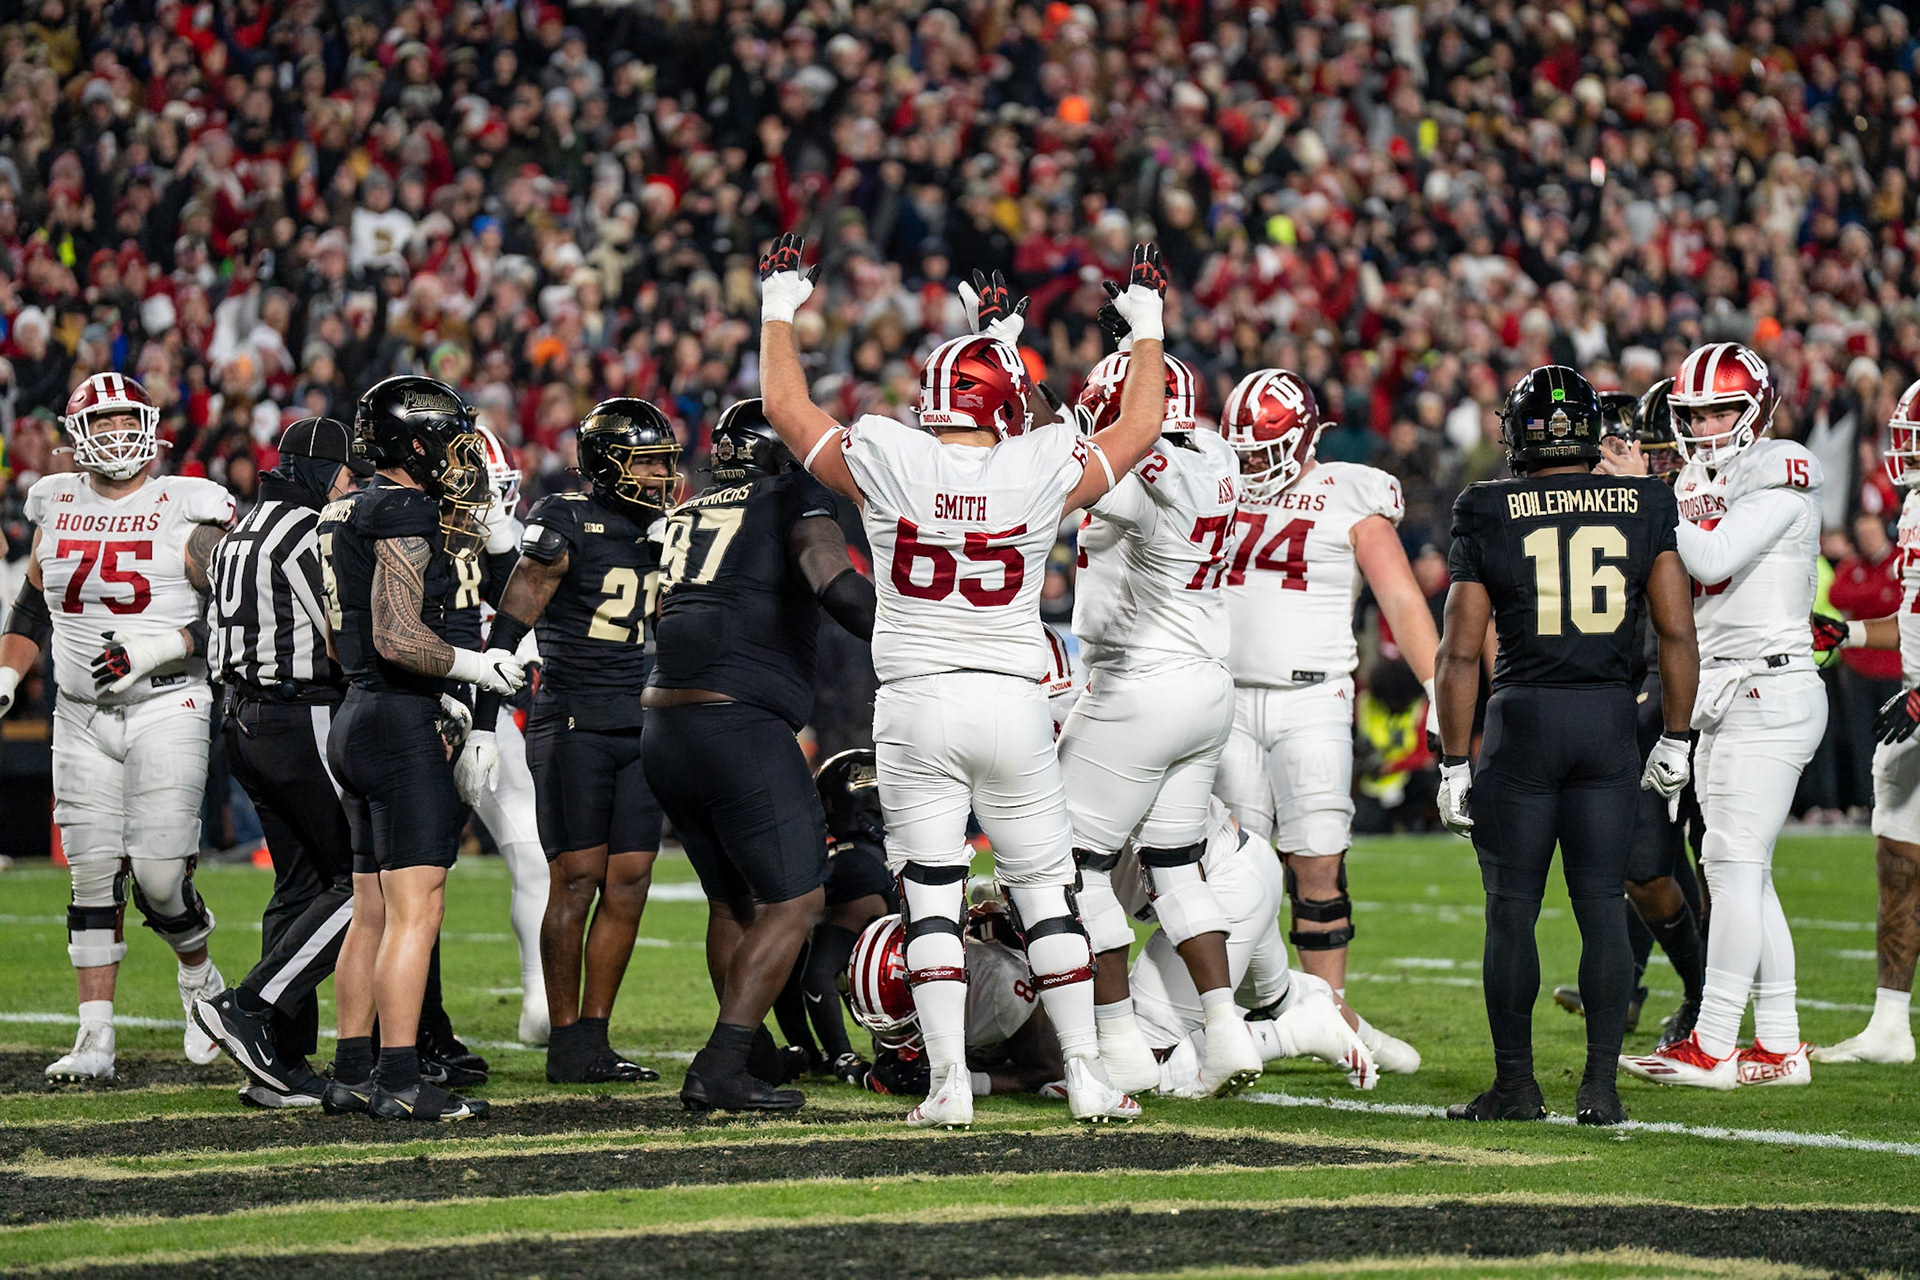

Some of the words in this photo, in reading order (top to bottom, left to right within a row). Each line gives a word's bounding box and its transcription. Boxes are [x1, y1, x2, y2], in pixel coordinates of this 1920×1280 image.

[1785, 459, 1810, 488] 15
[55, 513, 161, 533] HOOSIERS
[934, 493, 986, 521] SMITH
[1507, 487, 1639, 519] BOILERMAKERS
[657, 508, 746, 585] 97
[891, 516, 1027, 607] 65
[1227, 511, 1315, 591] 74
[56, 539, 153, 614] 75
[222, 540, 254, 618] U
[1523, 524, 1628, 636] 16
[920, 970, 955, 978] DONJOY
[1043, 973, 1076, 985] DONJOY
